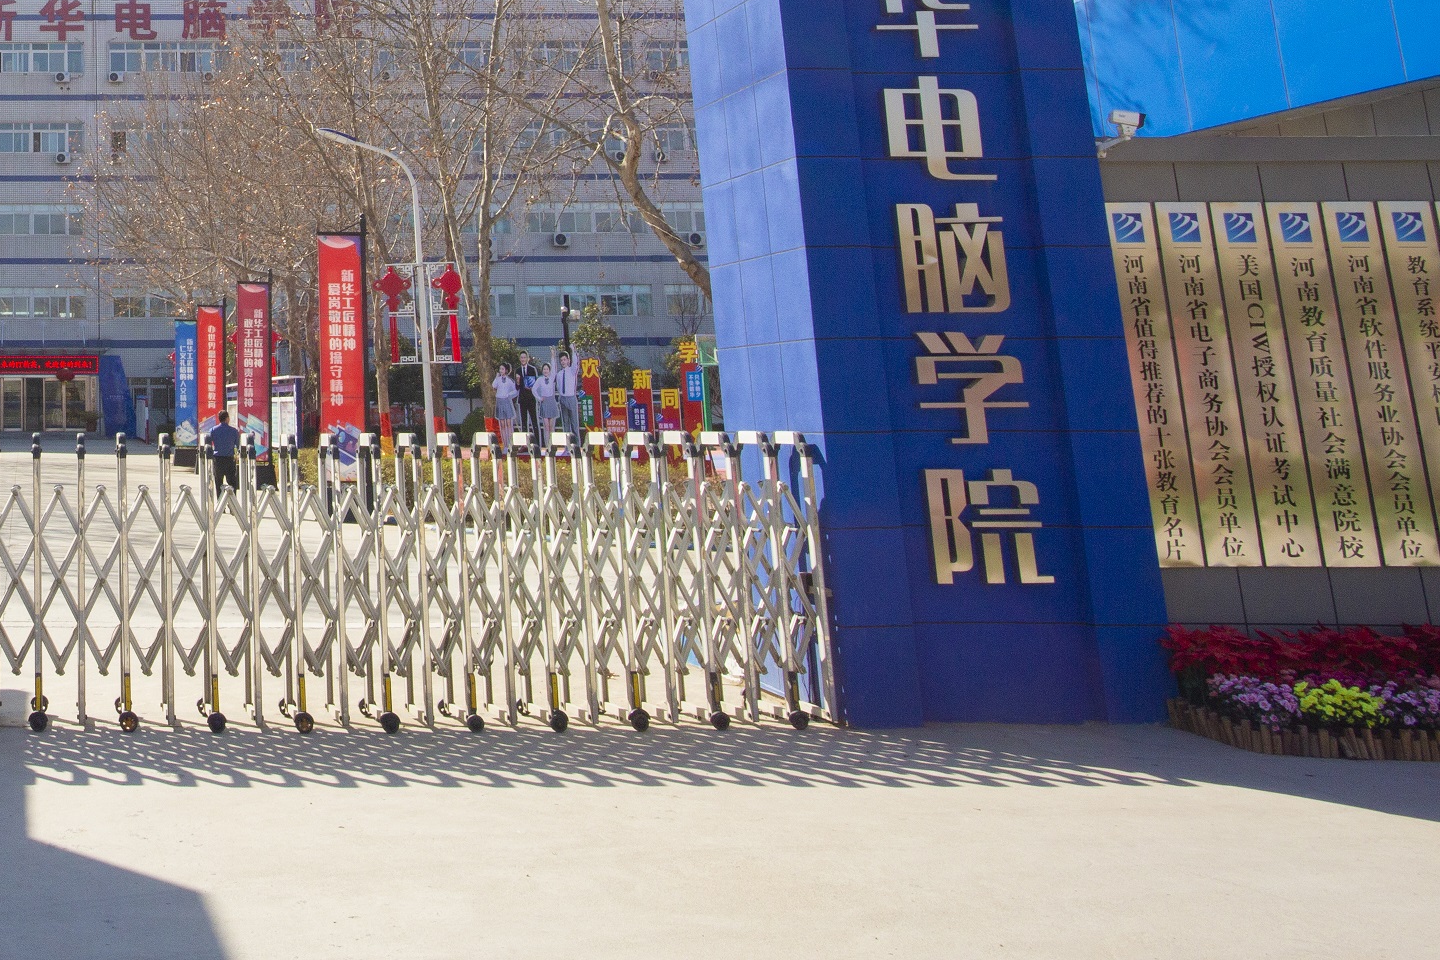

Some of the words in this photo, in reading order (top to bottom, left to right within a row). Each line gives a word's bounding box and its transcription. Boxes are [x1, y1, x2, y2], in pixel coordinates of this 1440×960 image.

[244, 318, 253, 407] 敢于担当的责任精神
[253, 309, 263, 368] 新华工匠精神
[328, 283, 344, 406] 爱岗敬业的操守精神
[341, 269, 356, 351] 新华工匠精神
[581, 358, 600, 378] 欢
[608, 387, 627, 408] 迎
[633, 369, 652, 390] 新
[661, 388, 680, 409] 同
[678, 342, 698, 364] 学
[1407, 255, 1440, 427] 教育系统平安
[1123, 254, 1184, 561] 河南省值得推荐的十张教育名片
[1178, 254, 1245, 559] 河南省电子商务协会会员单位
[1237, 254, 1305, 559] 美国CIW授权认证考试中心
[1291, 256, 1364, 559] 河南教育质量社会满意院校
[1347, 254, 1424, 559] 河南省软件服务业协会会员单位
